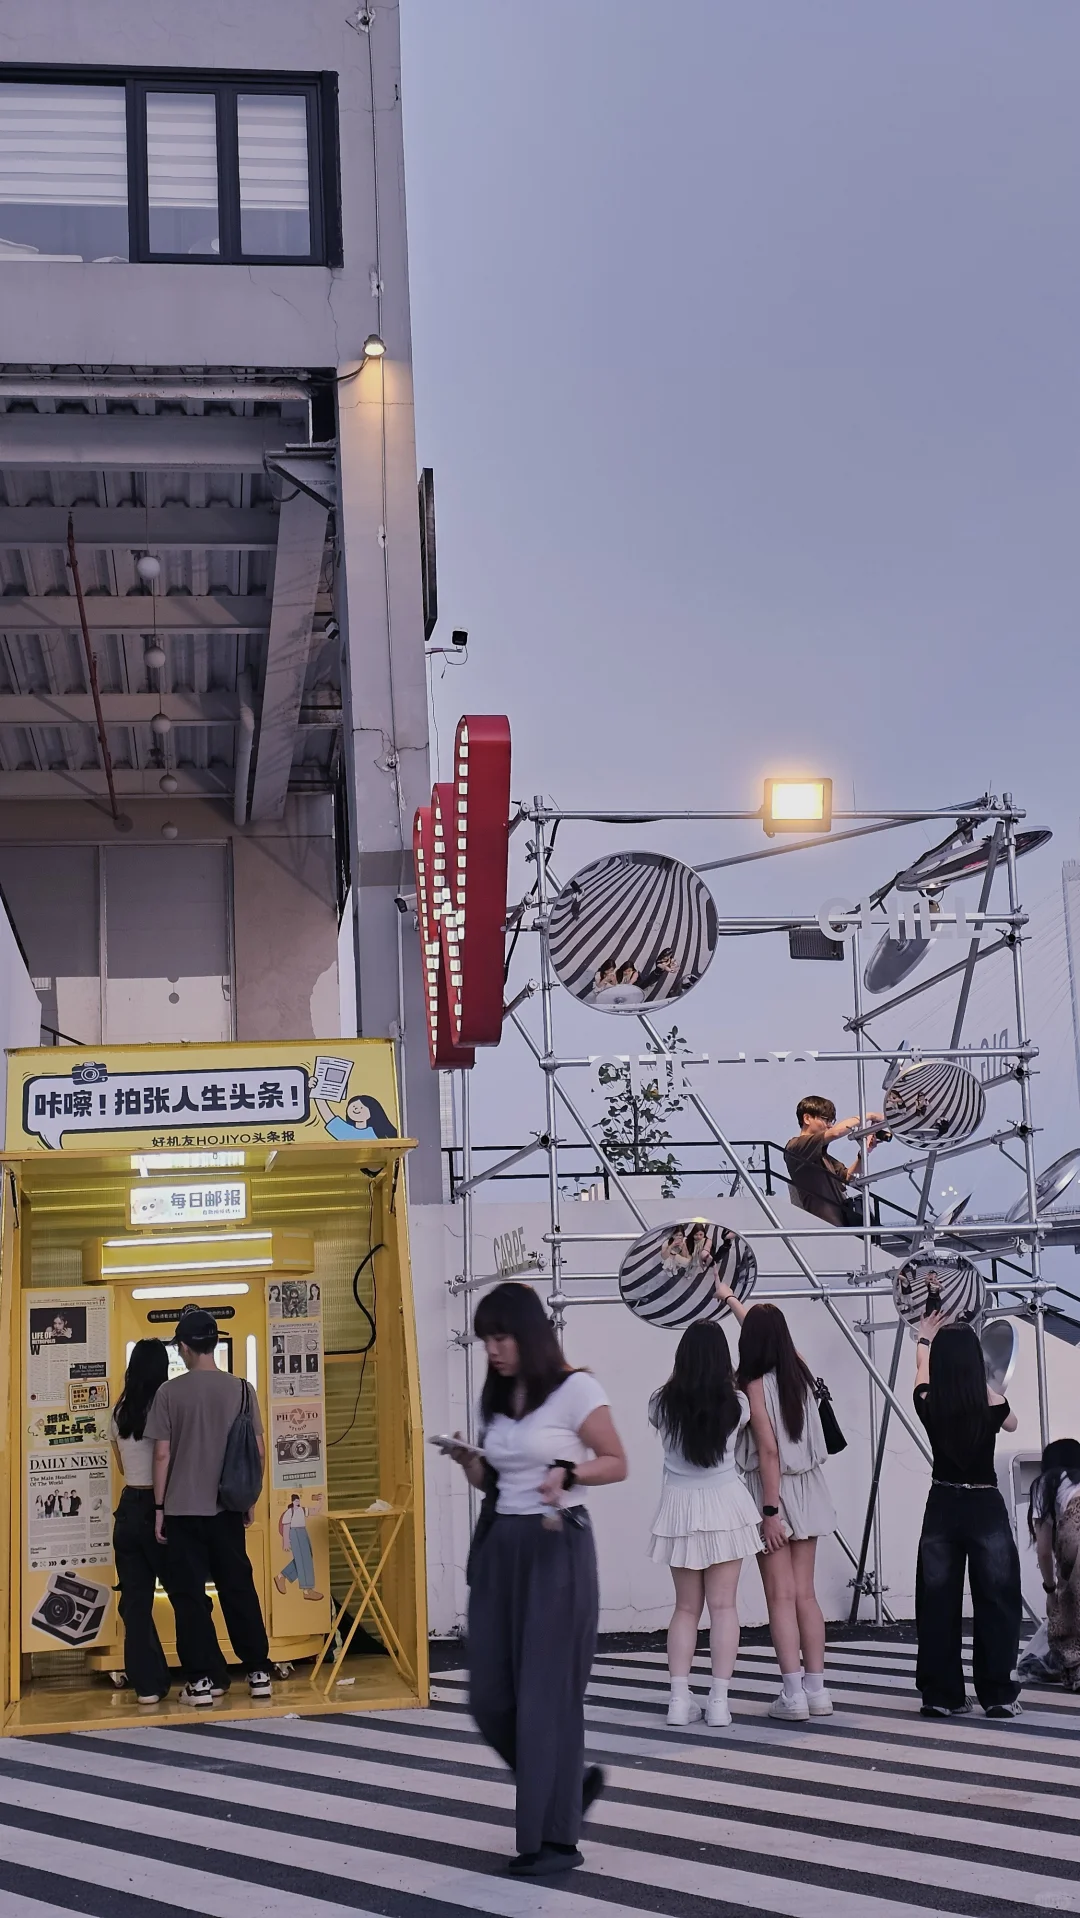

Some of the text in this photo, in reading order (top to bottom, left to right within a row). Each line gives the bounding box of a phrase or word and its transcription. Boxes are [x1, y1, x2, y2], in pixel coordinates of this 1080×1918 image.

[818, 897, 989, 941] CHILL
[589, 1050, 817, 1097] CHE
[34, 1081, 299, 1119] 咔嚓！拍张人生头条！
[170, 1189, 241, 1209] 每日邮报
[494, 1226, 527, 1275] CARPE
[30, 1344, 40, 1355] W
[44, 1423, 97, 1436] 要上头条
[30, 1455, 107, 1470] DAILY NEWS
